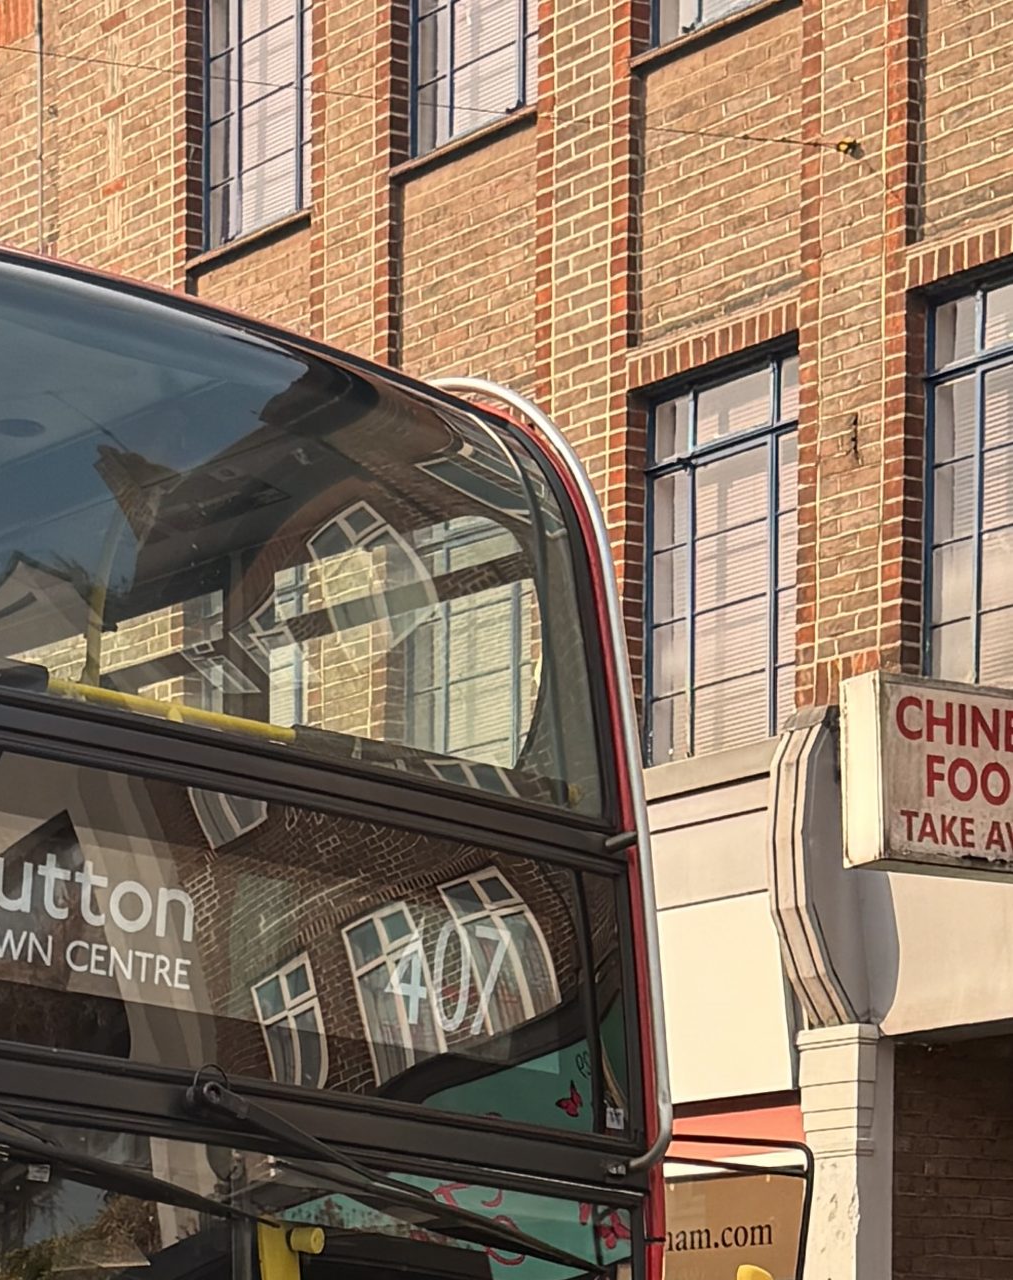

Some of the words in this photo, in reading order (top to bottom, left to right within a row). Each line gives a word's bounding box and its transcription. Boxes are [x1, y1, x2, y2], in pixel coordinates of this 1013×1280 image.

[927, 754, 1011, 806] FOO
[900, 809, 975, 848] TAKE
[66, 940, 192, 990] CENTRE
[385, 916, 510, 1036] 407
